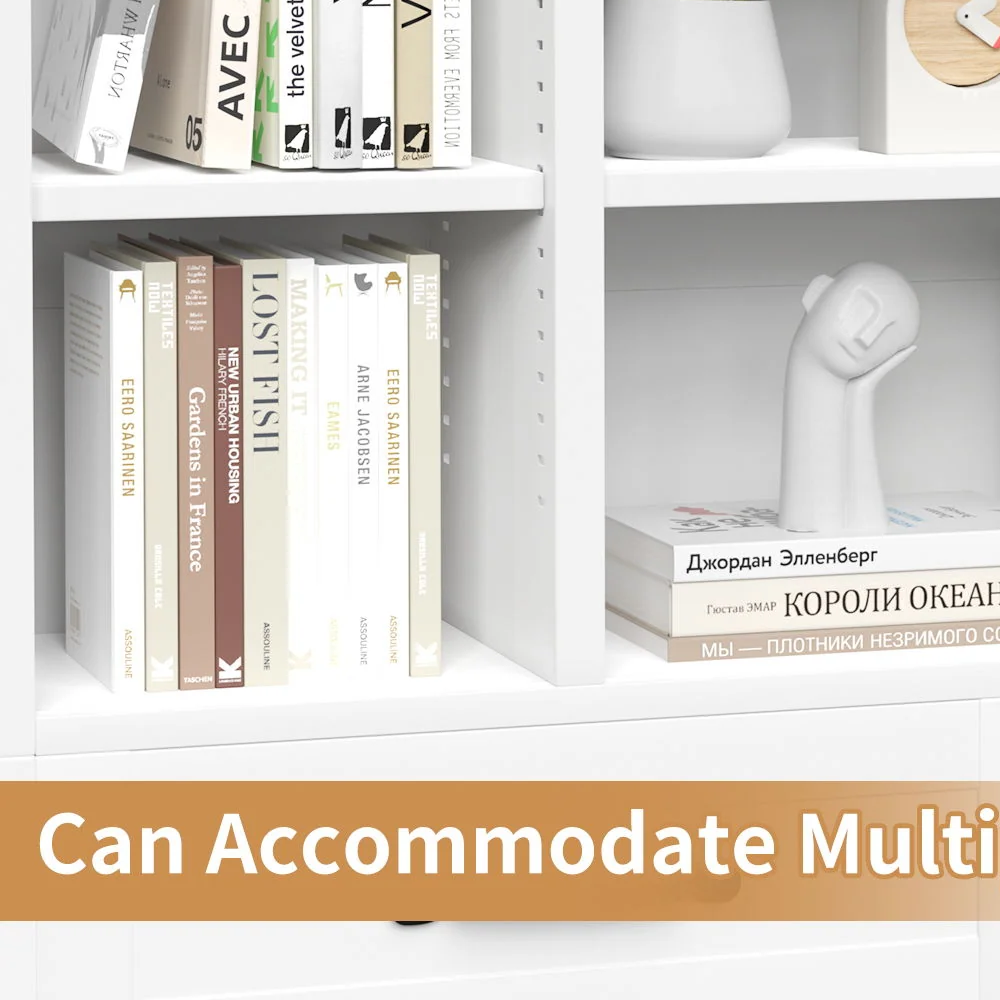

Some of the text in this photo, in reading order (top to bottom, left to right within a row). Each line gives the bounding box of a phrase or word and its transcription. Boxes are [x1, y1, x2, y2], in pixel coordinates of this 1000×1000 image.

[217, 13, 251, 121] AVEC
[286, 64, 305, 98] the
[185, 114, 203, 151] 05
[252, 273, 280, 453] LOST FISH
[228, 347, 240, 504] NEW URBAN HOUSING
[356, 365, 371, 485] ARNE JACOBSEN
[387, 369, 400, 485] EERO SAARINEN
[188, 386, 207, 572] Gardens in France
[686, 547, 879, 574] Джордан Элленберг
[706, 601, 777, 615] Гюстав ЭМАР
[784, 586, 901, 617] КОРОЛИ
[702, 642, 734, 658] МЫ
[767, 634, 865, 655] ПЛОТНИКИ
[870, 627, 978, 649] НЕЗРИМОГО
